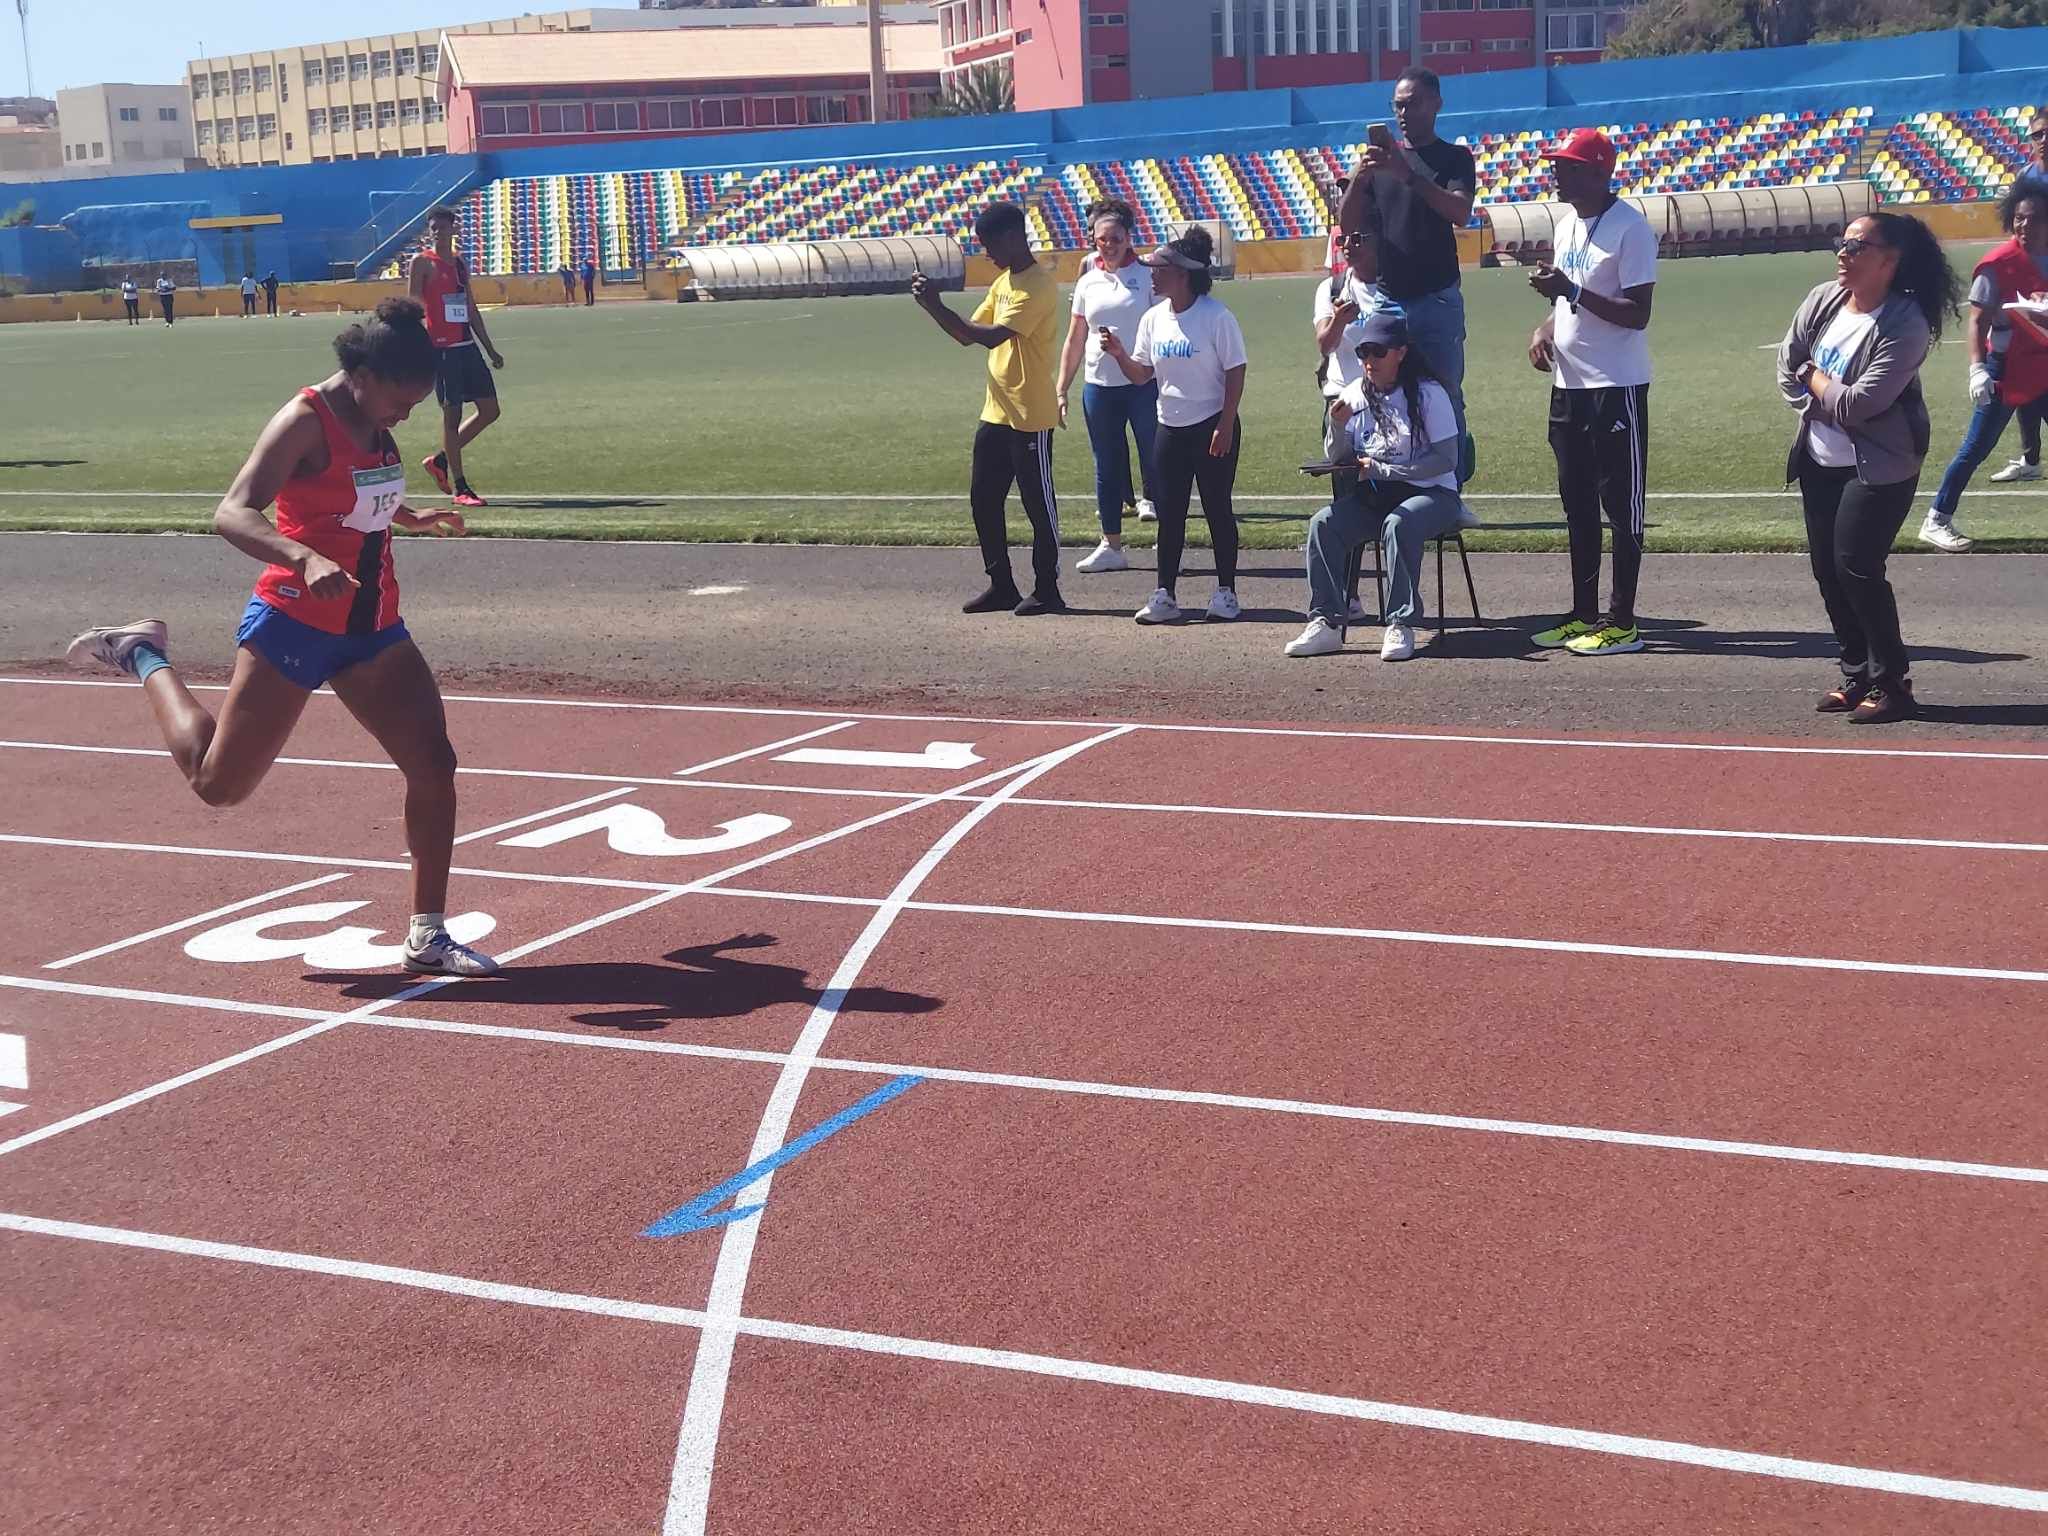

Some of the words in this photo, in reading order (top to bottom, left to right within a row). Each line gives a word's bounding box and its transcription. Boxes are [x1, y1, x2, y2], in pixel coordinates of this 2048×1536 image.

[770, 741, 986, 770] 1
[497, 803, 792, 857] 2
[184, 900, 497, 970] 3
